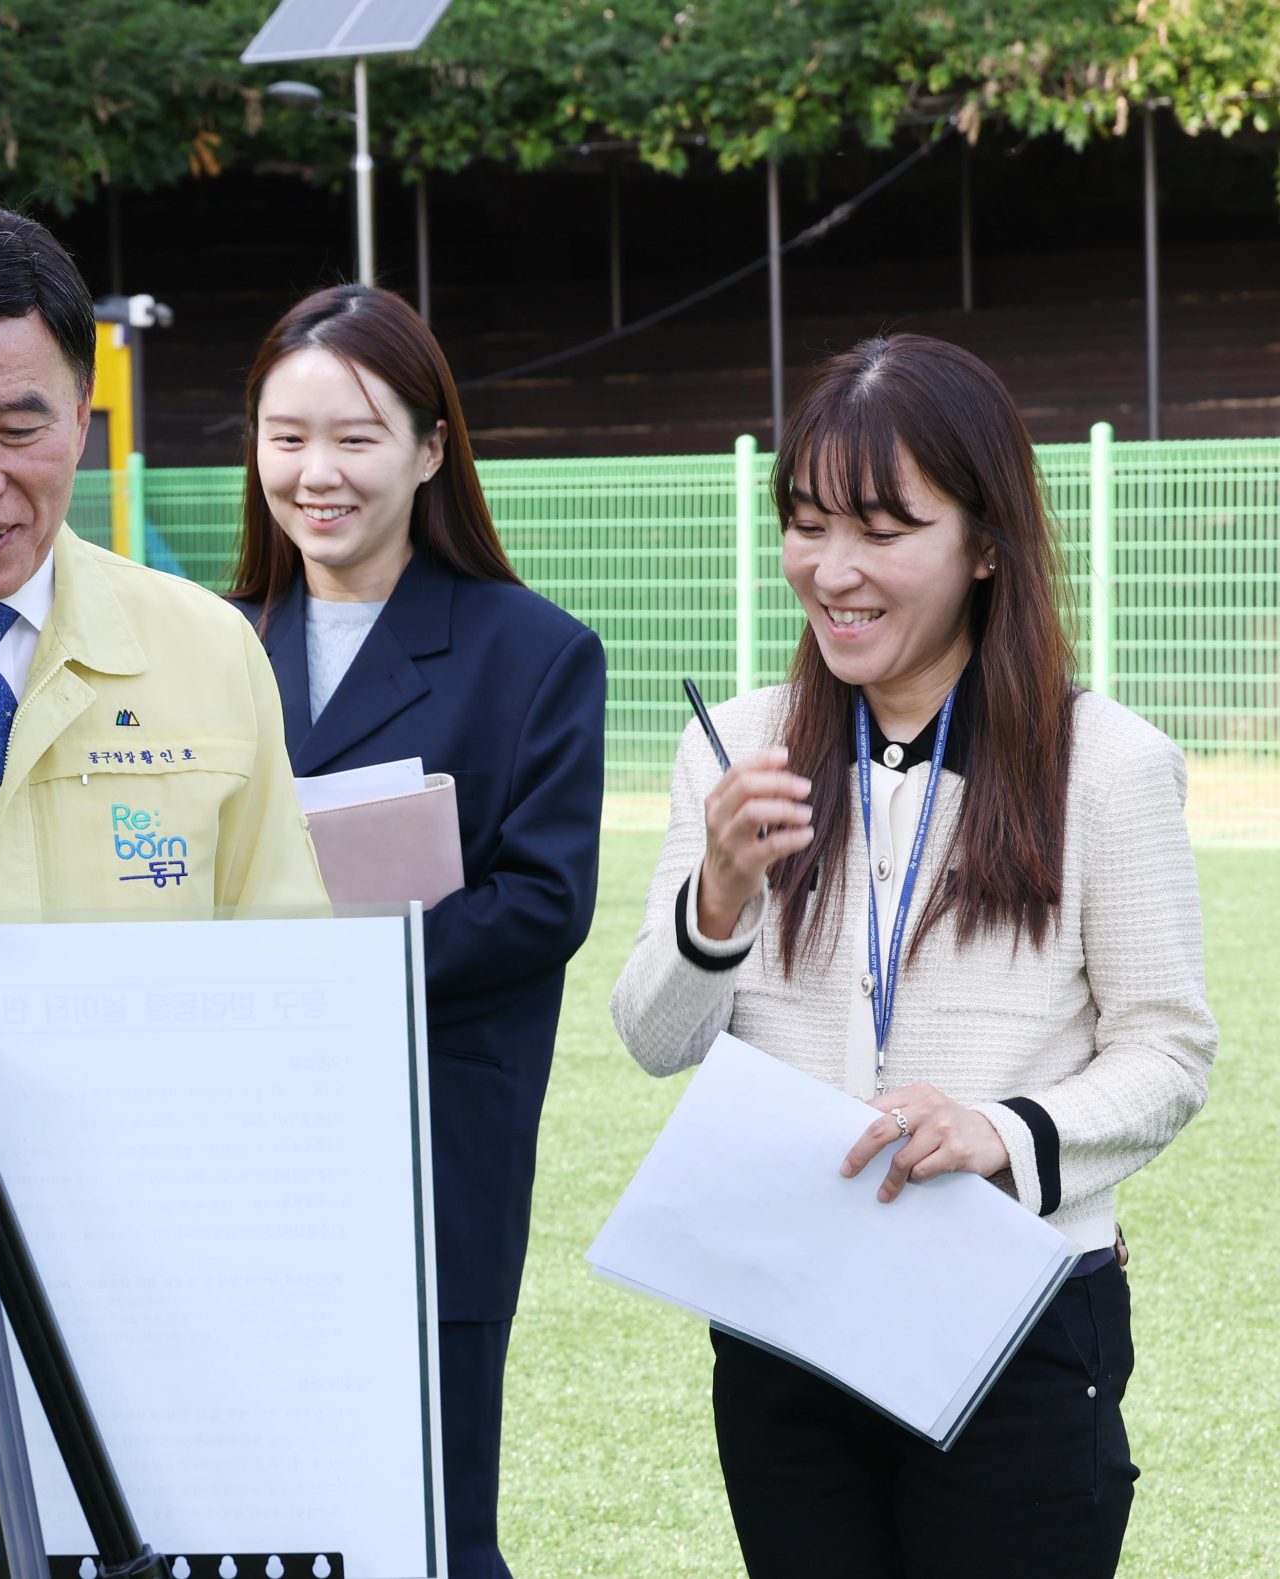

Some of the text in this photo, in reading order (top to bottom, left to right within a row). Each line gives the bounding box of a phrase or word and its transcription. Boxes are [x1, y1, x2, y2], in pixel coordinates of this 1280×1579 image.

[88, 751, 135, 764] 동구청장
[927, 755, 940, 797] METROPOLITAN
[148, 860, 189, 888] 동구
